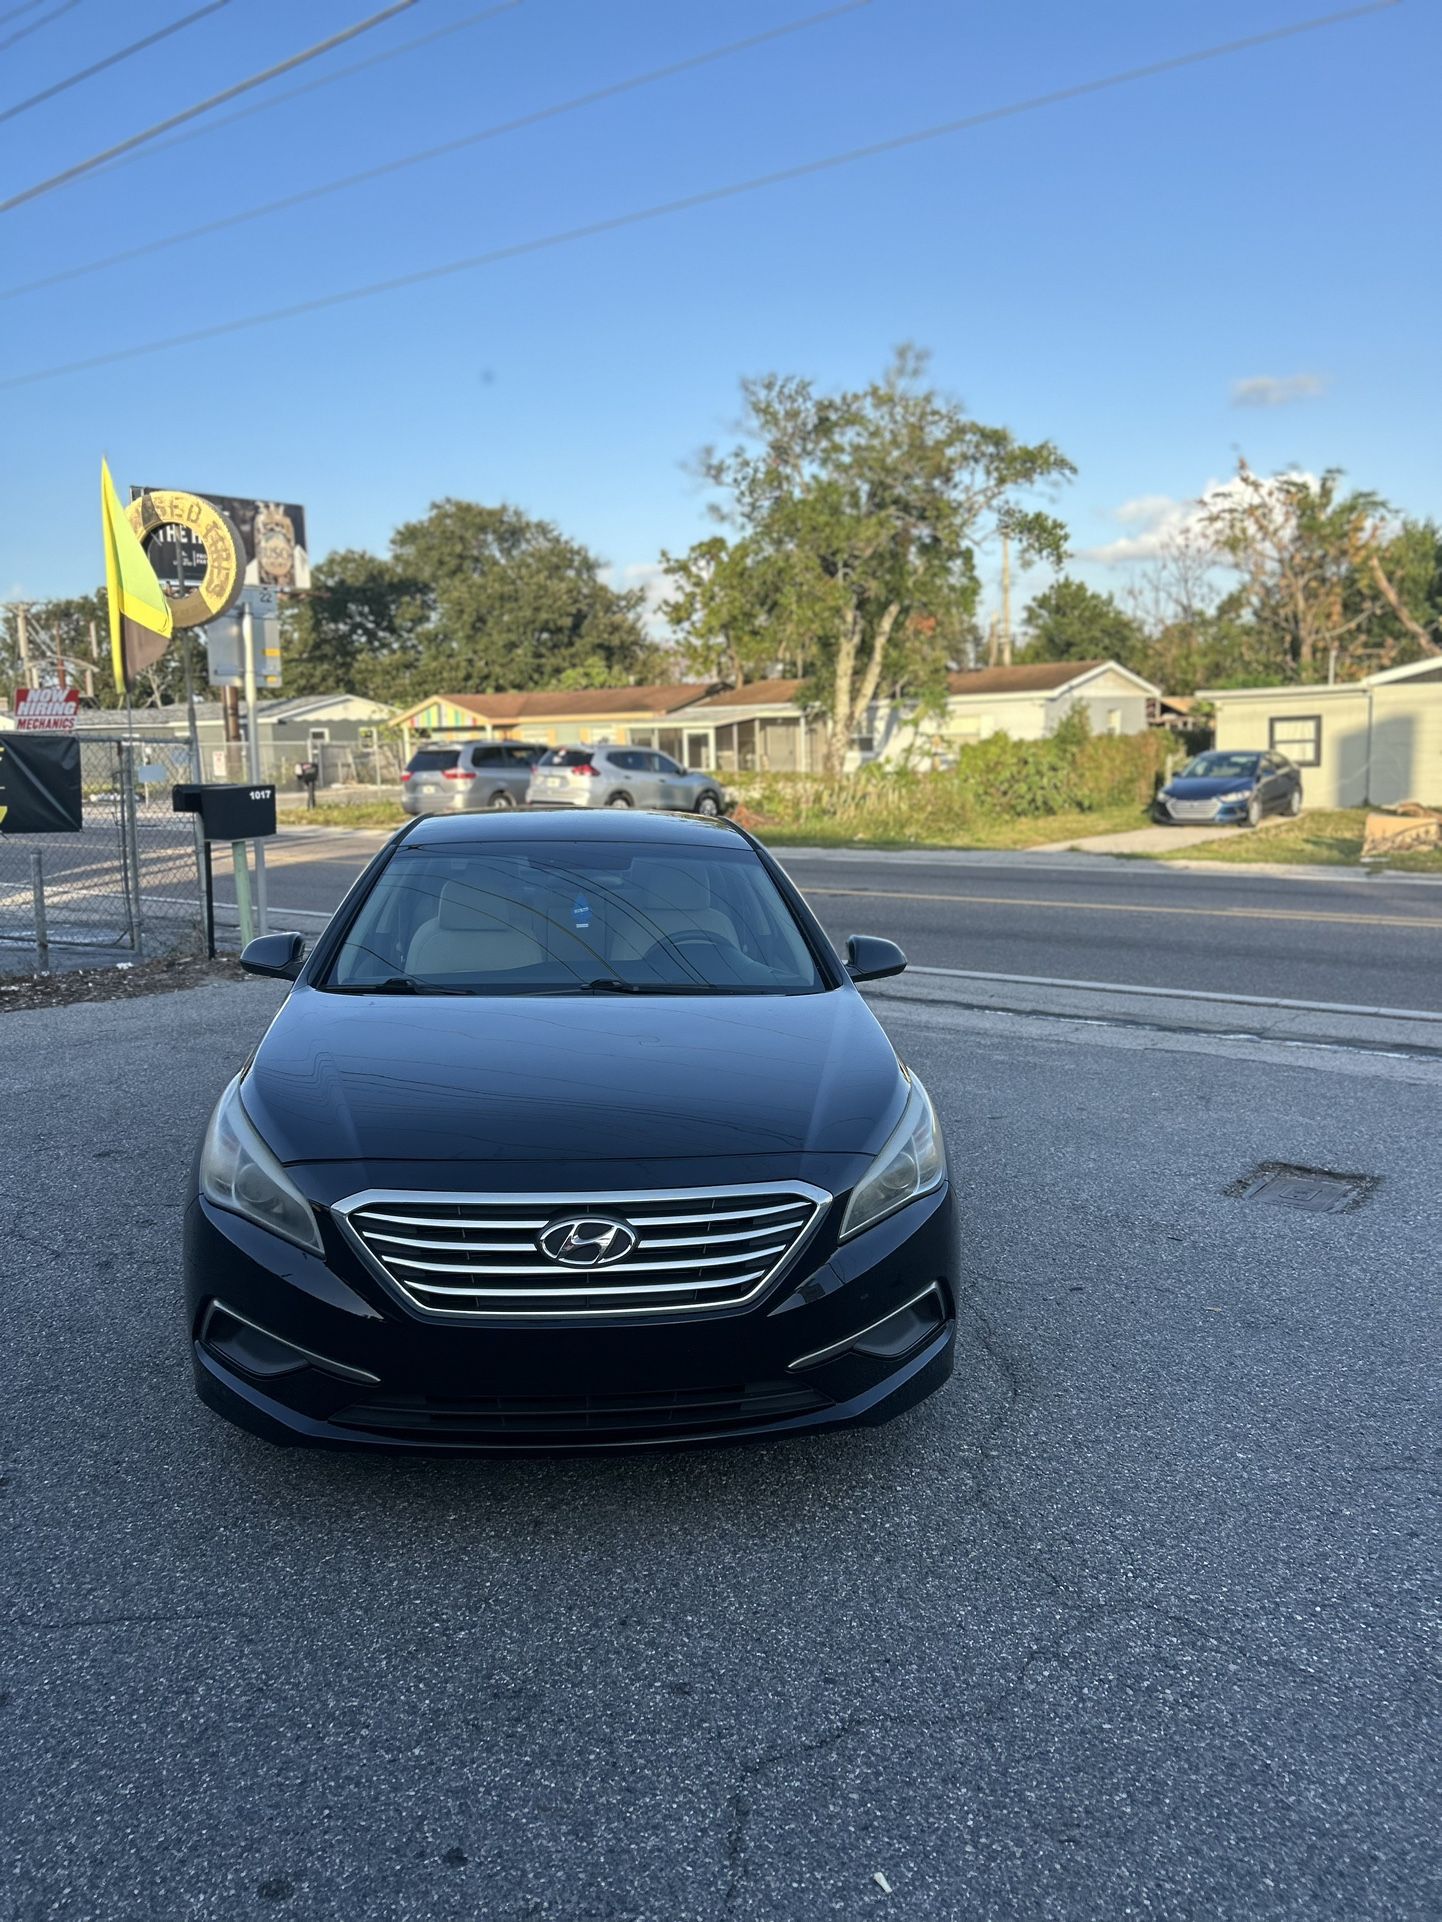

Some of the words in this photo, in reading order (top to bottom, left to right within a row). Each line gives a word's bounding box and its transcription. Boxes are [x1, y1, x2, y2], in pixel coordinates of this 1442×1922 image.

[259, 592, 272, 603] 22
[27, 688, 70, 702] NOW
[17, 701, 76, 716] HIRING
[17, 718, 75, 730] MECHANICS
[249, 789, 272, 800] 1017
